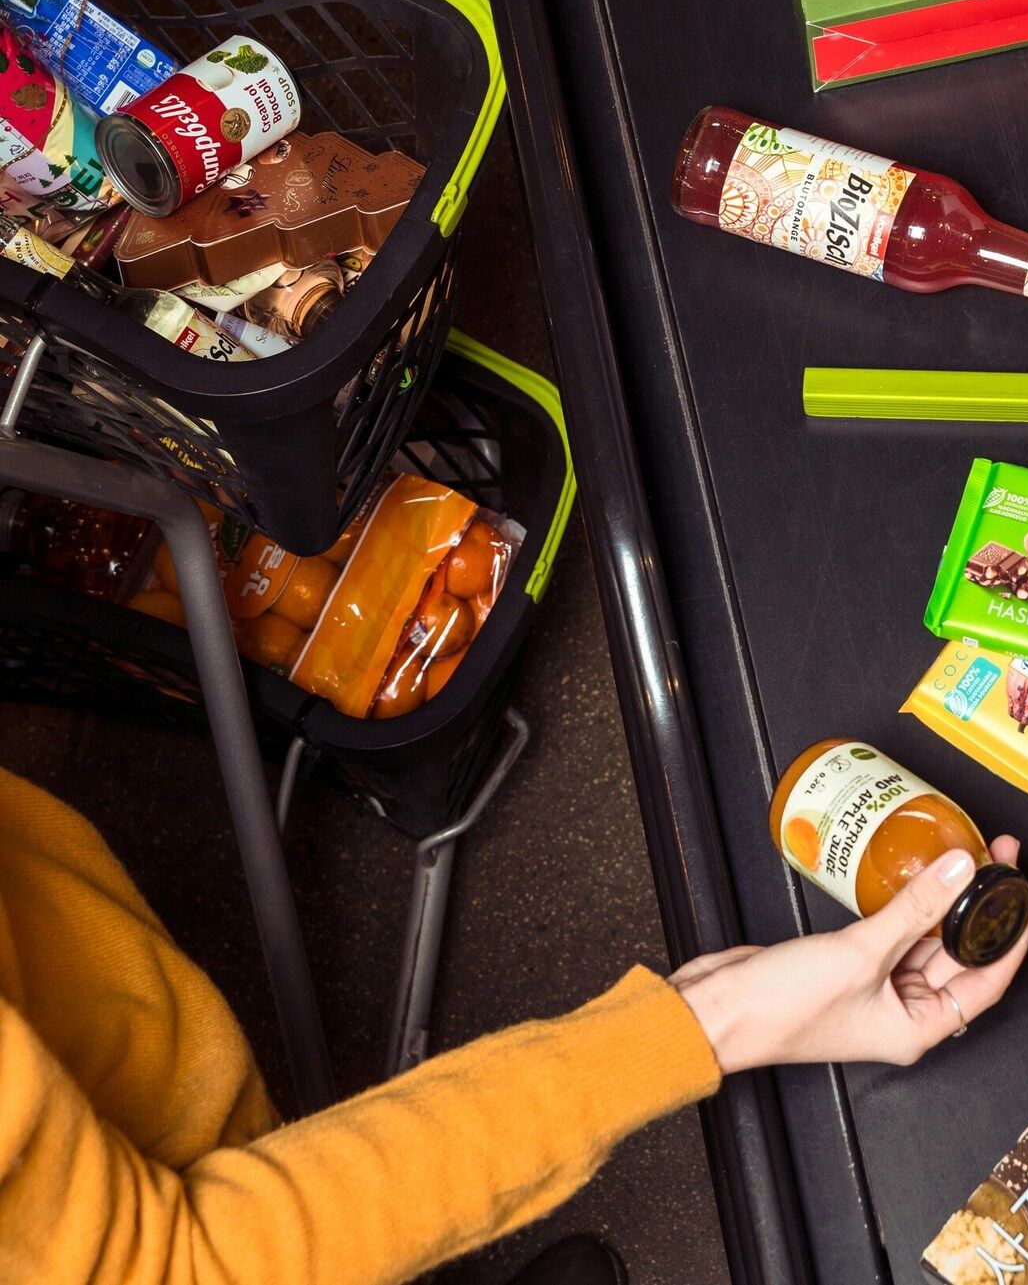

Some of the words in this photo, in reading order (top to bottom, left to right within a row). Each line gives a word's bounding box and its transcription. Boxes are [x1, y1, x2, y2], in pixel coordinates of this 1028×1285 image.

[247, 82, 261, 97] of
[257, 78, 282, 125] Broccoli
[276, 75, 297, 108] SOUP
[258, 97, 273, 135] Cream
[789, 172, 815, 244] BLUTORANGE
[865, 783, 910, 813] 100%
[876, 773, 903, 791] AND
[838, 789, 873, 832] APPLE
[825, 833, 842, 878] JUICE
[839, 813, 869, 879] APRICOT
